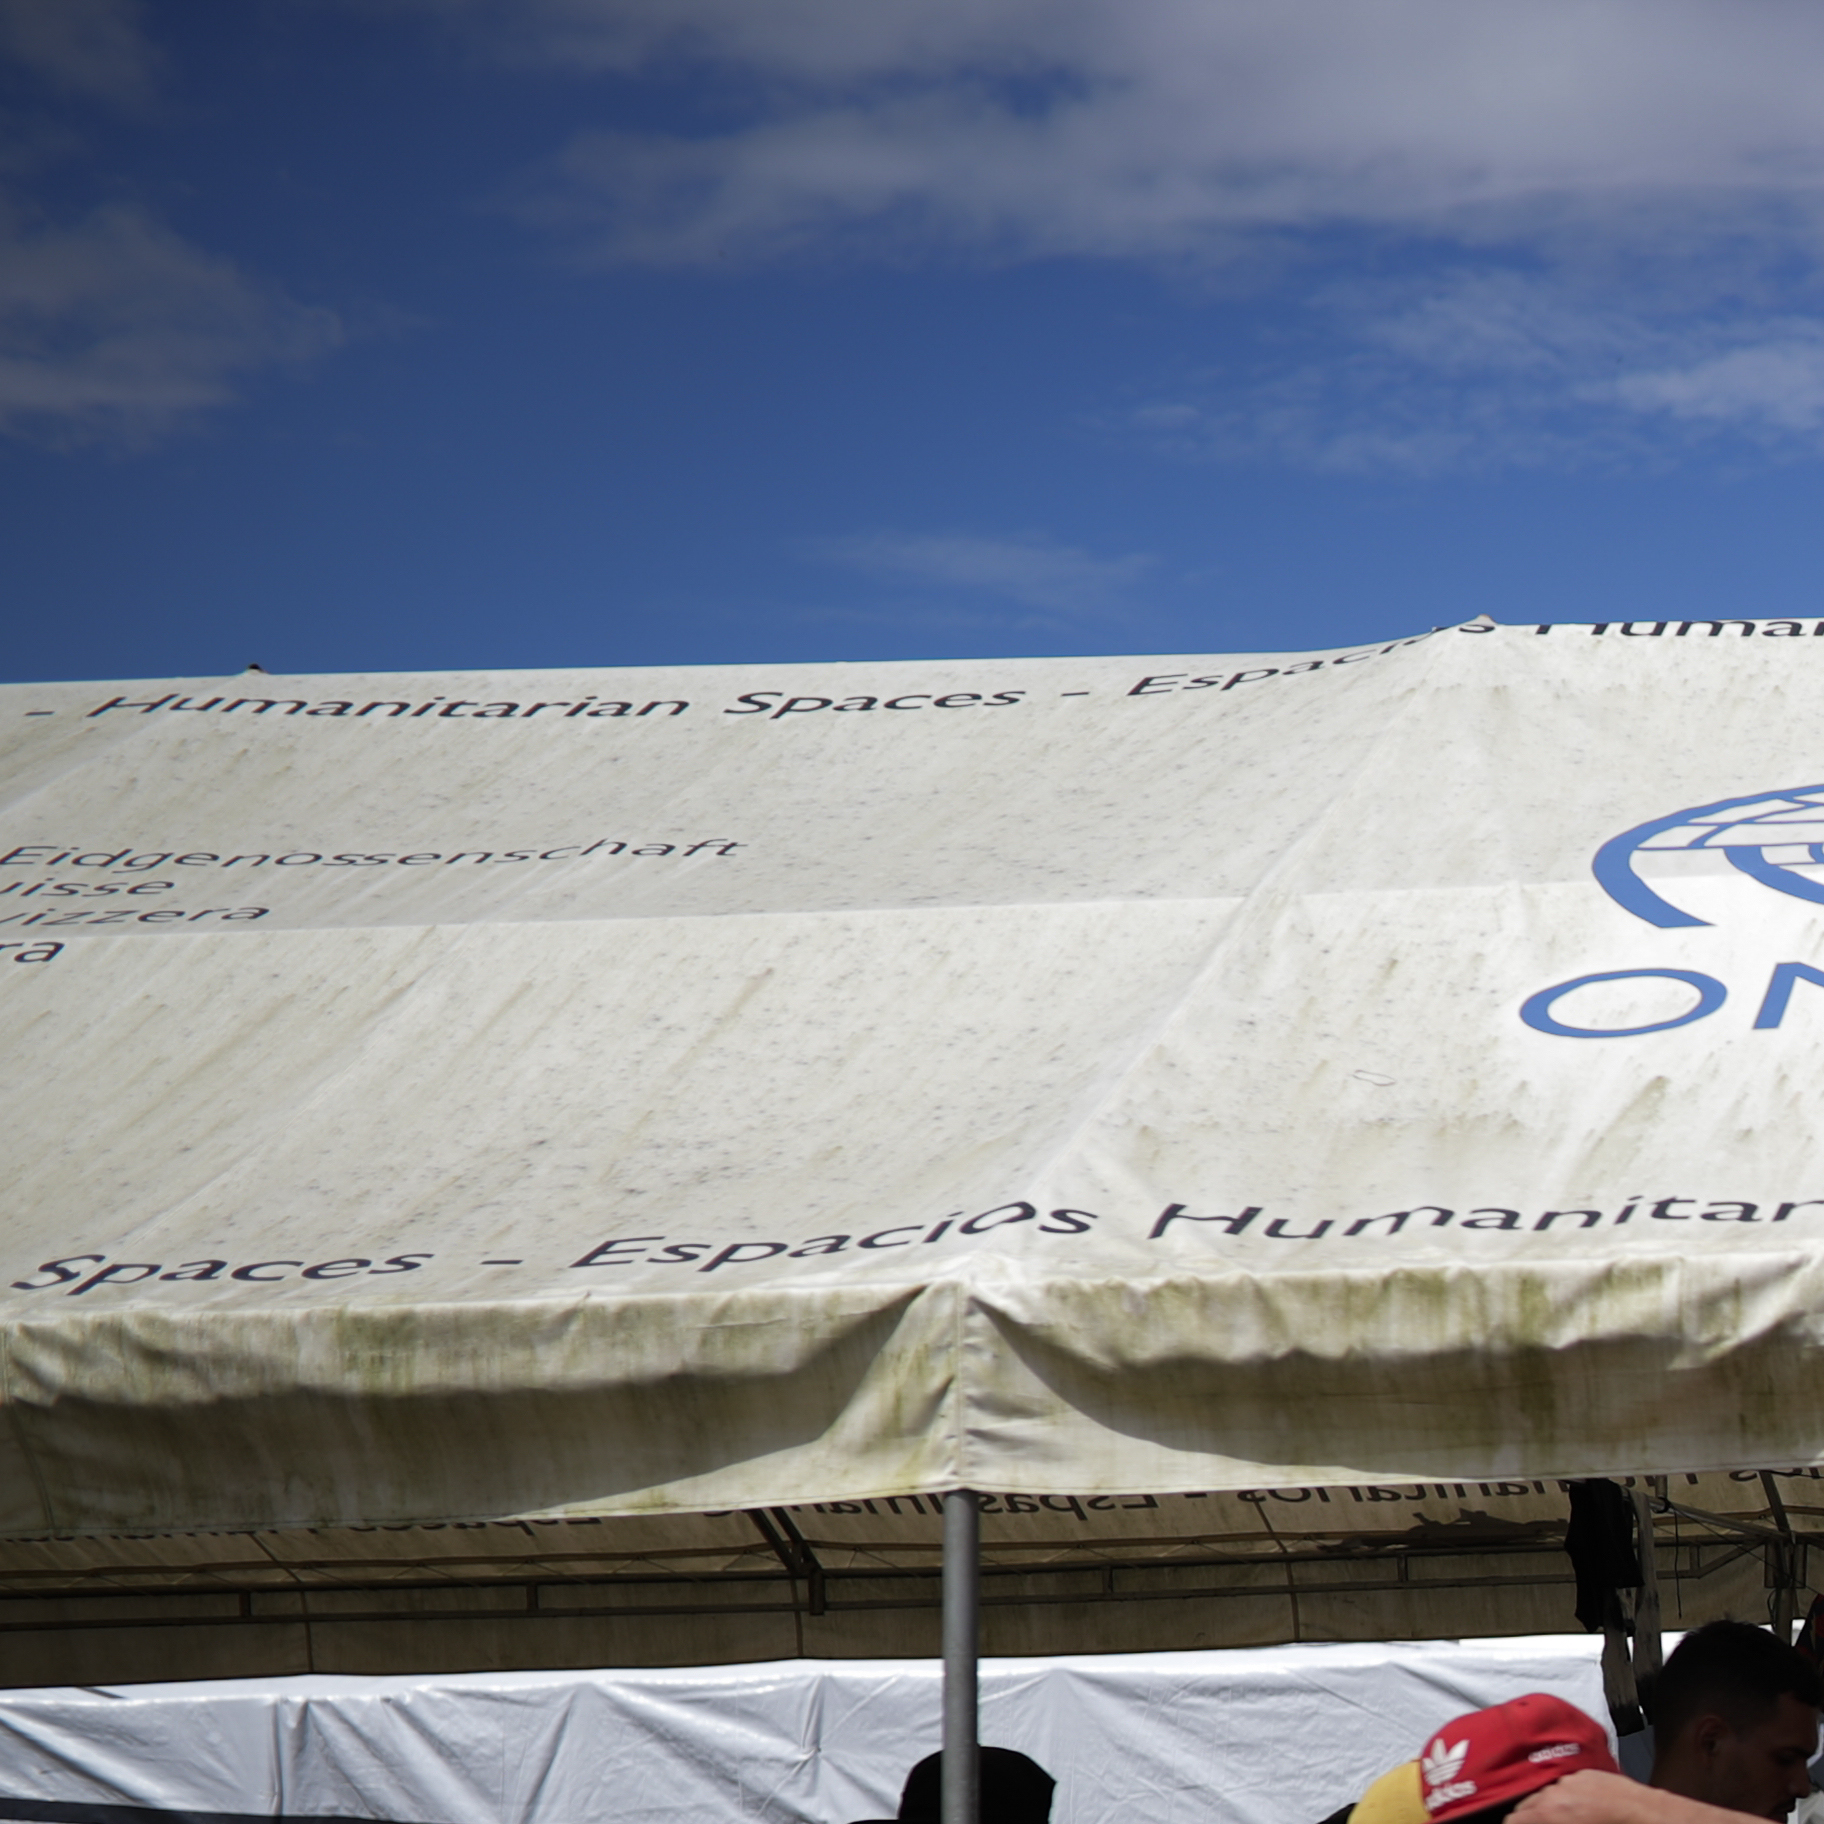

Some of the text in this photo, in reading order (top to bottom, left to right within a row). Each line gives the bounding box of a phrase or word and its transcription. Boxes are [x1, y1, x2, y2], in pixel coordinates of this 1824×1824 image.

[87, 692, 690, 719] Humanitarian
[723, 689, 1027, 721] Spaces
[1128, 622, 1497, 697] Espacis
[0, 838, 749, 874] Eidgenossenschaft
[11, 1253, 434, 1297] Spaces
[570, 1200, 1098, 1272] Espacios
